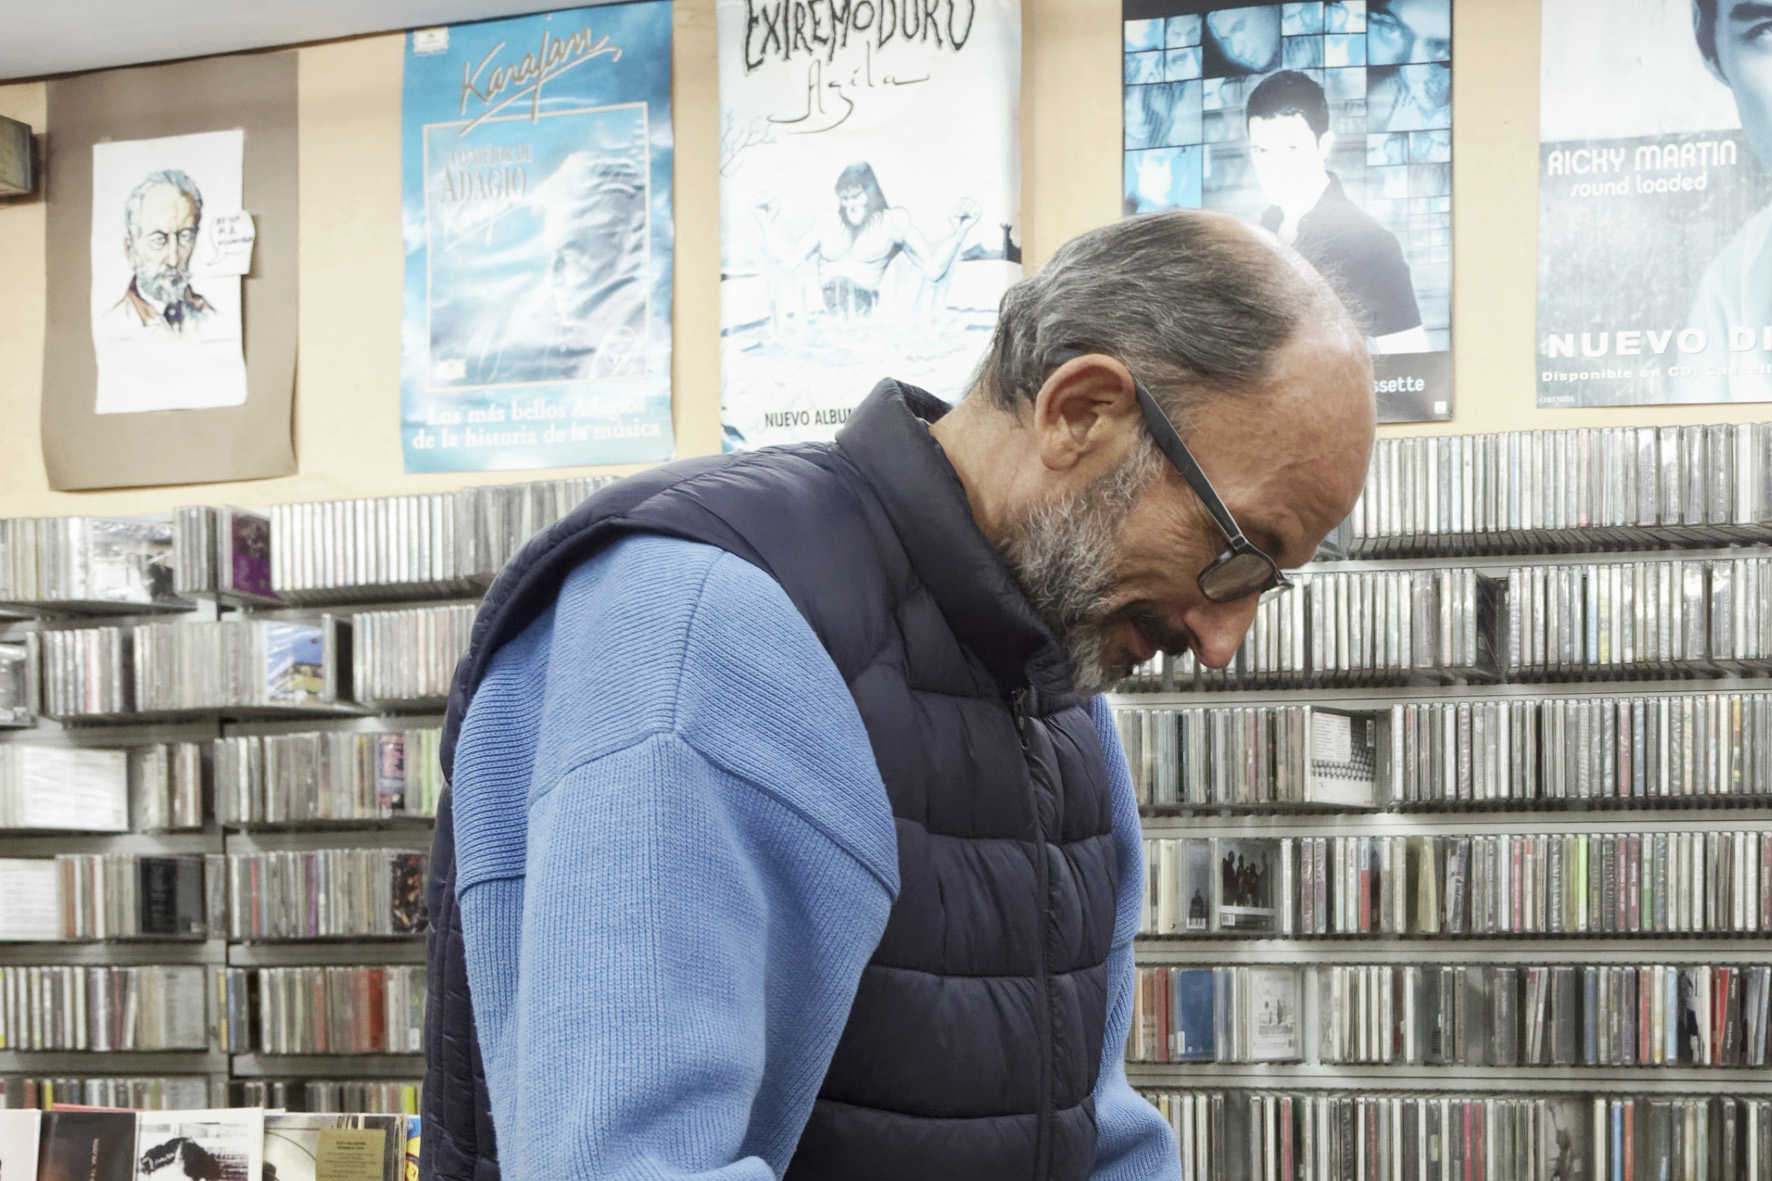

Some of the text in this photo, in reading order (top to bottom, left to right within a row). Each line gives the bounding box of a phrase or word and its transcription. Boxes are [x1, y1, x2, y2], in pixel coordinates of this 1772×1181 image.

[459, 13, 622, 135] Karajan
[766, 40, 930, 135] Agila
[1548, 139, 1737, 176] RICKY MARTIN
[1570, 171, 1708, 198] sound loaded
[1546, 328, 1707, 358] NUEVO
[1542, 368, 1632, 382] Disponible
[1640, 366, 1660, 379] en
[764, 407, 856, 428] NUEVO ALBU
